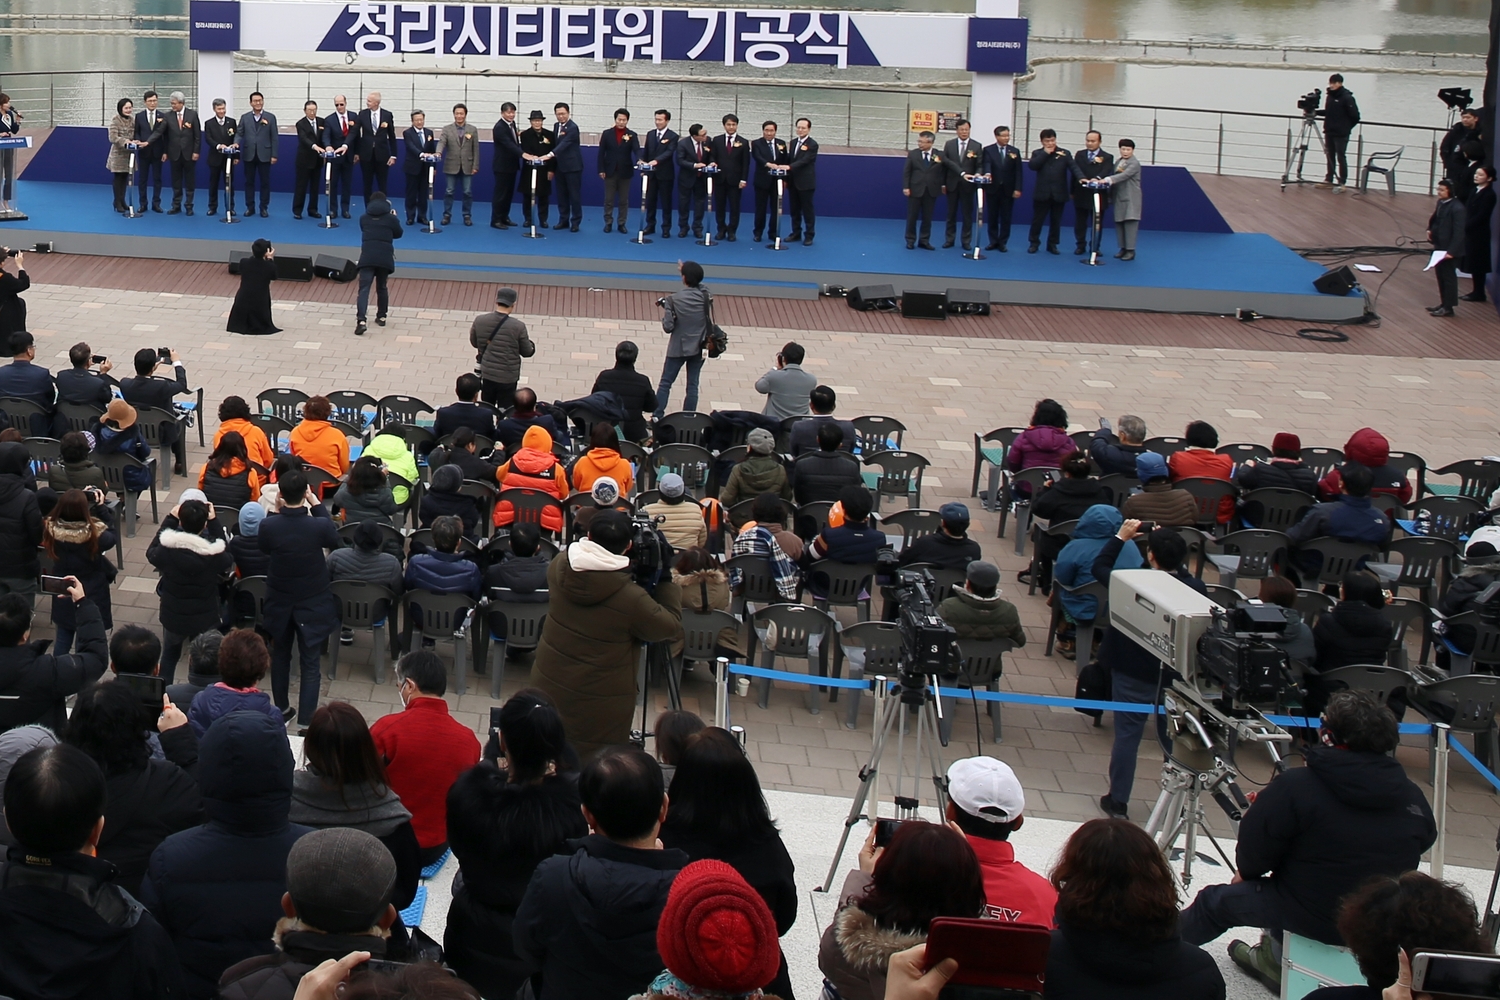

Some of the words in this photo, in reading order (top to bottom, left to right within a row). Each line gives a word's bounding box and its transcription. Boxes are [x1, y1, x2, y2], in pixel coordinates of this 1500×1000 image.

[346, 0, 663, 64] 청라시티타워
[686, 9, 849, 69] 기공식
[930, 644, 938, 653] 3
[1263, 666, 1270, 675] 7
